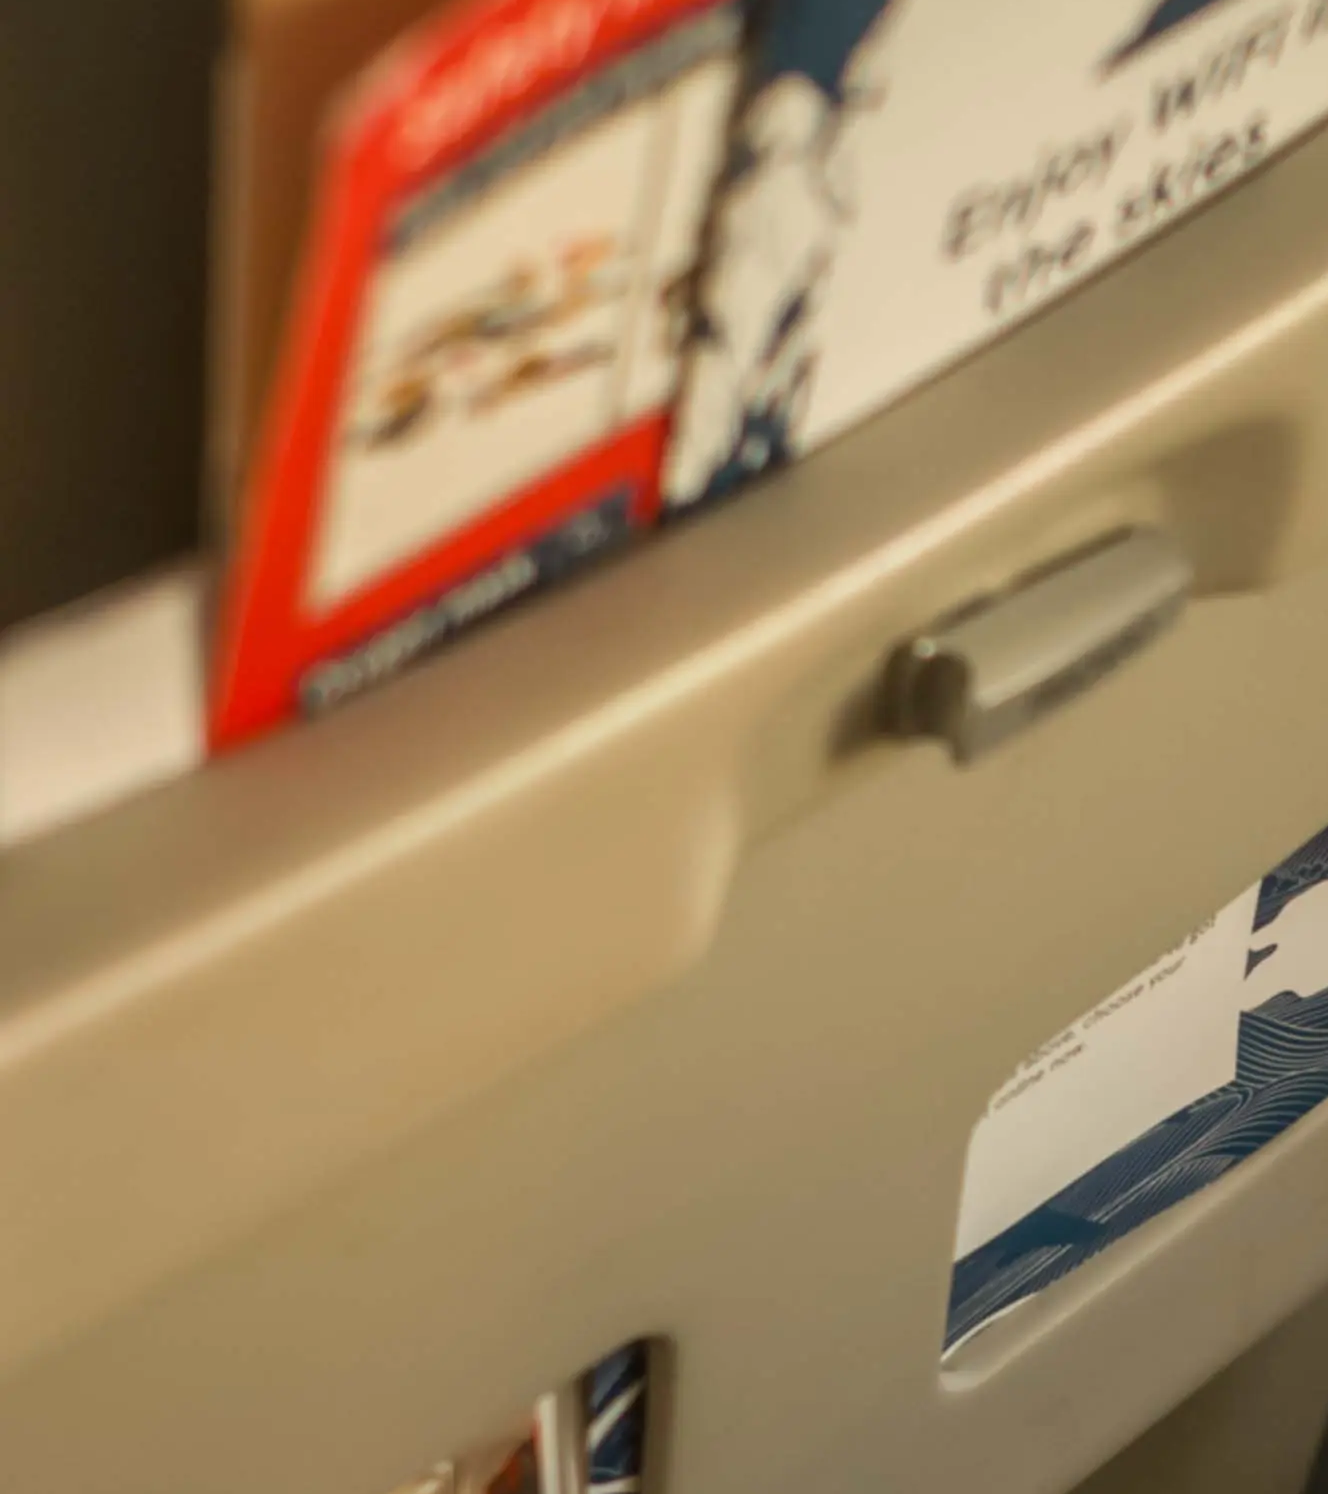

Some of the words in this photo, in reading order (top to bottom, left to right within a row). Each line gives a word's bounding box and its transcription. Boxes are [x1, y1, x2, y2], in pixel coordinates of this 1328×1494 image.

[941, 116, 1132, 264] Enjoy
[982, 217, 1097, 314] the
[1112, 108, 1270, 240] skies
